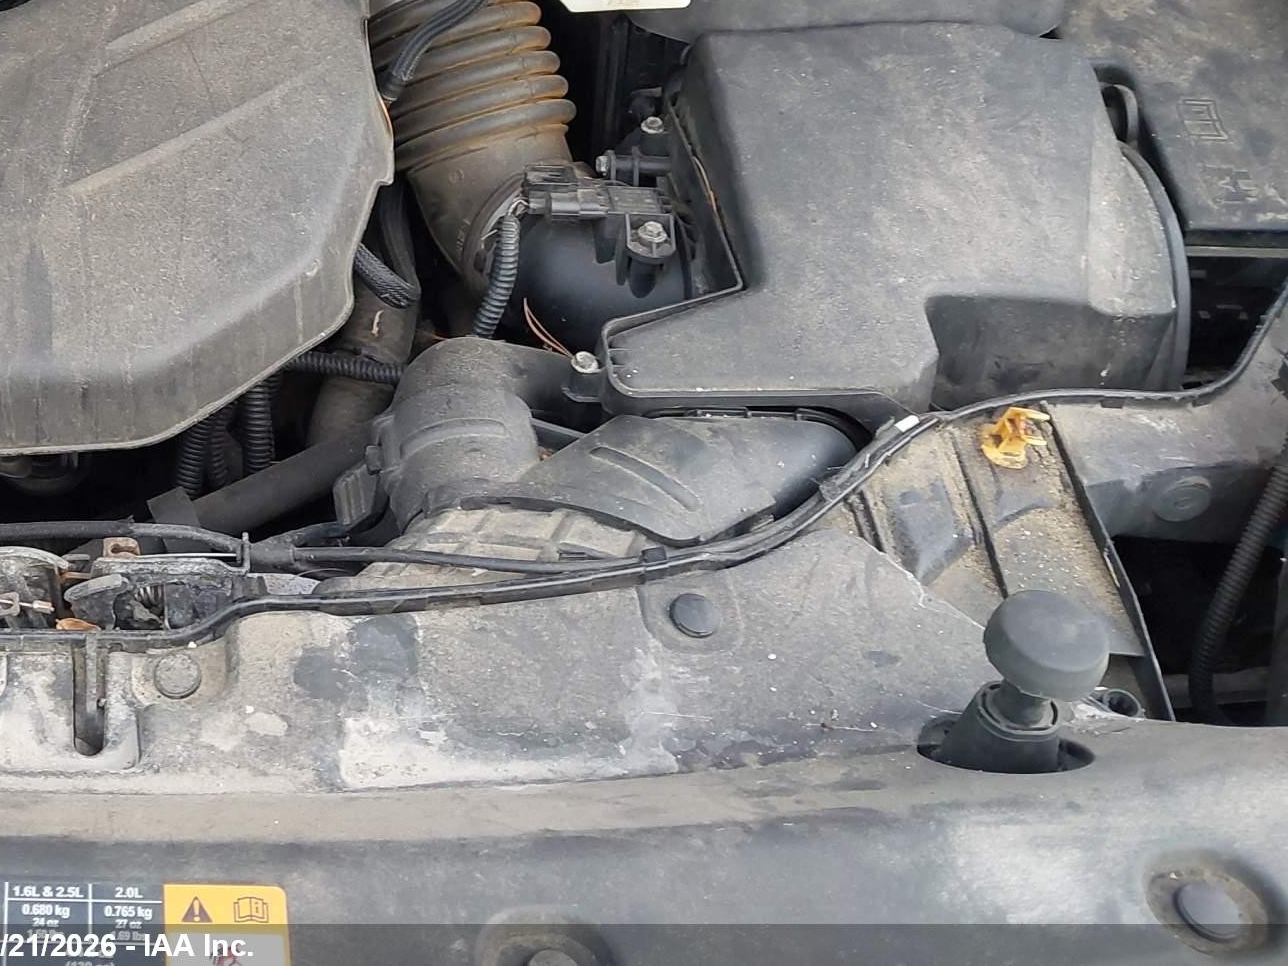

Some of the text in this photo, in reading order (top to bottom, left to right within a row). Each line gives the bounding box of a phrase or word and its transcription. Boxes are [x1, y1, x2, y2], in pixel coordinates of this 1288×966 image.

[13, 886, 84, 898] 1.6L & 2.5L
[114, 887, 143, 898] 2.0L
[21, 903, 70, 919] 0.680 kg
[104, 905, 153, 920] 0.765 kg
[32, 917, 59, 928] 24 oz
[115, 919, 142, 929] 27 oz
